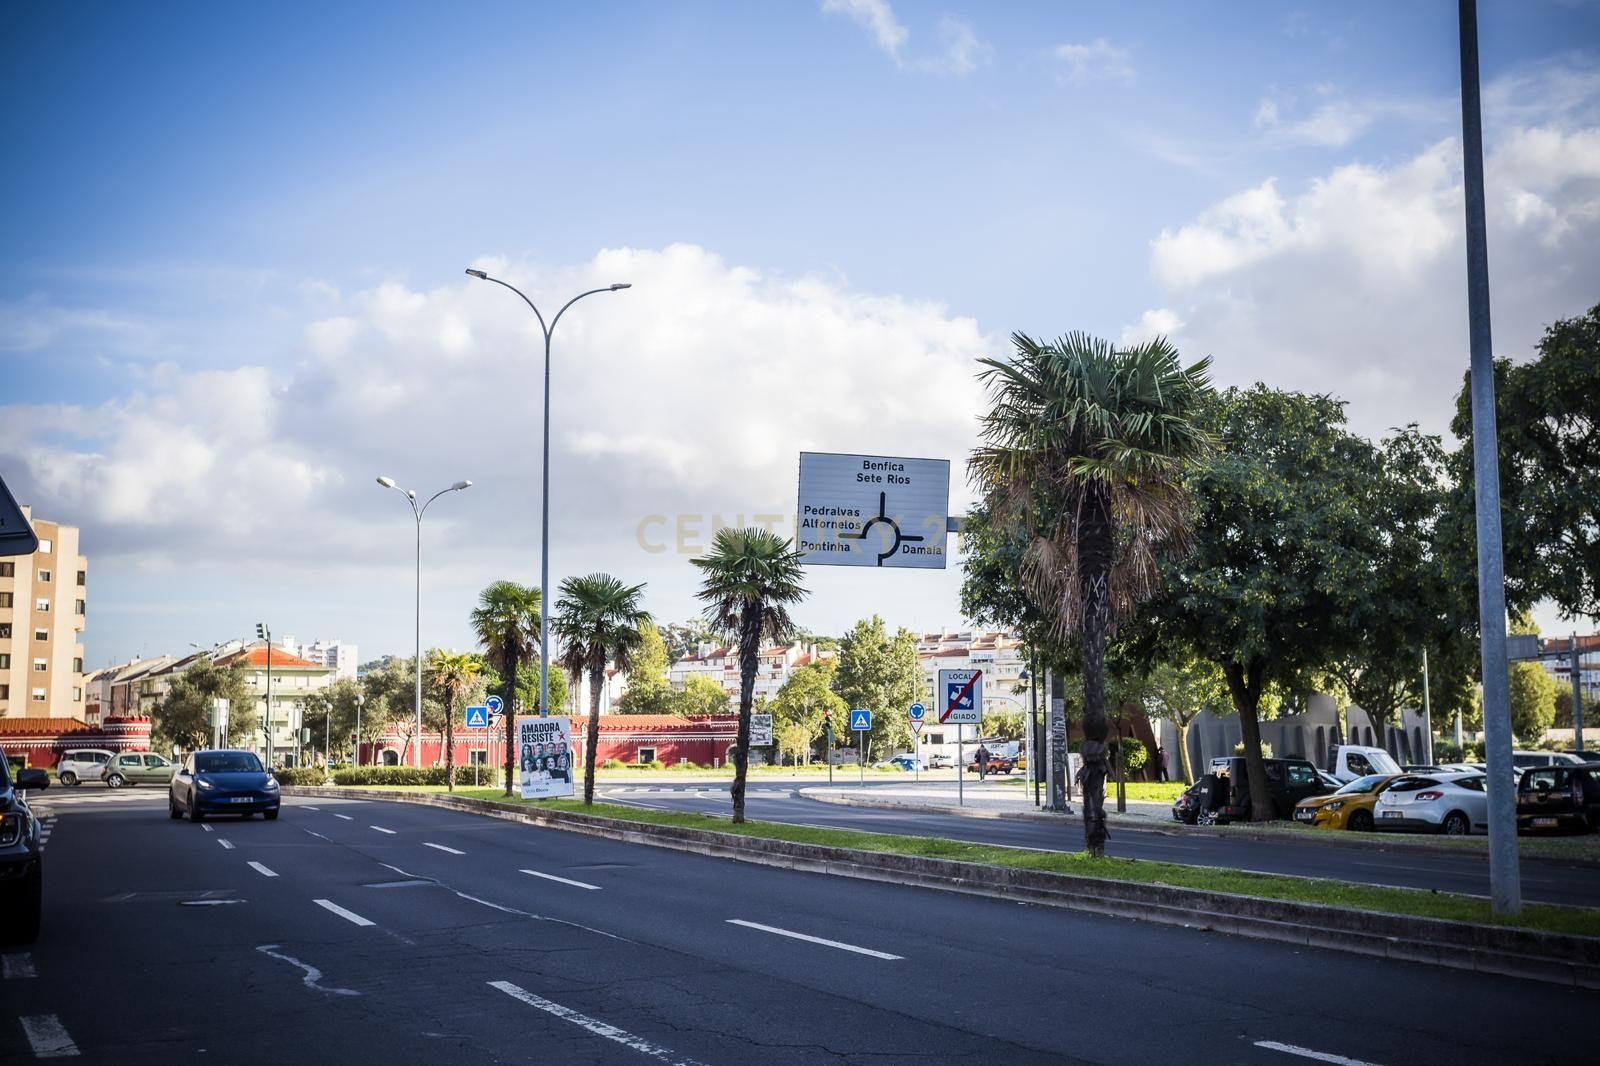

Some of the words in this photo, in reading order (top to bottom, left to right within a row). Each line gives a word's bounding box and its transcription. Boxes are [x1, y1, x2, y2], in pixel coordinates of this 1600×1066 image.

[863, 460, 904, 472] Benfica
[856, 473, 882, 483] Sete
[887, 474, 911, 485] Rios
[804, 505, 860, 517] Pedralvas
[802, 518, 861, 530] Alfornelos
[801, 540, 851, 552] Pontinha
[902, 544, 942, 555] Damaia
[521, 722, 560, 735] AMADORA
[521, 732, 554, 744] RESISTE
